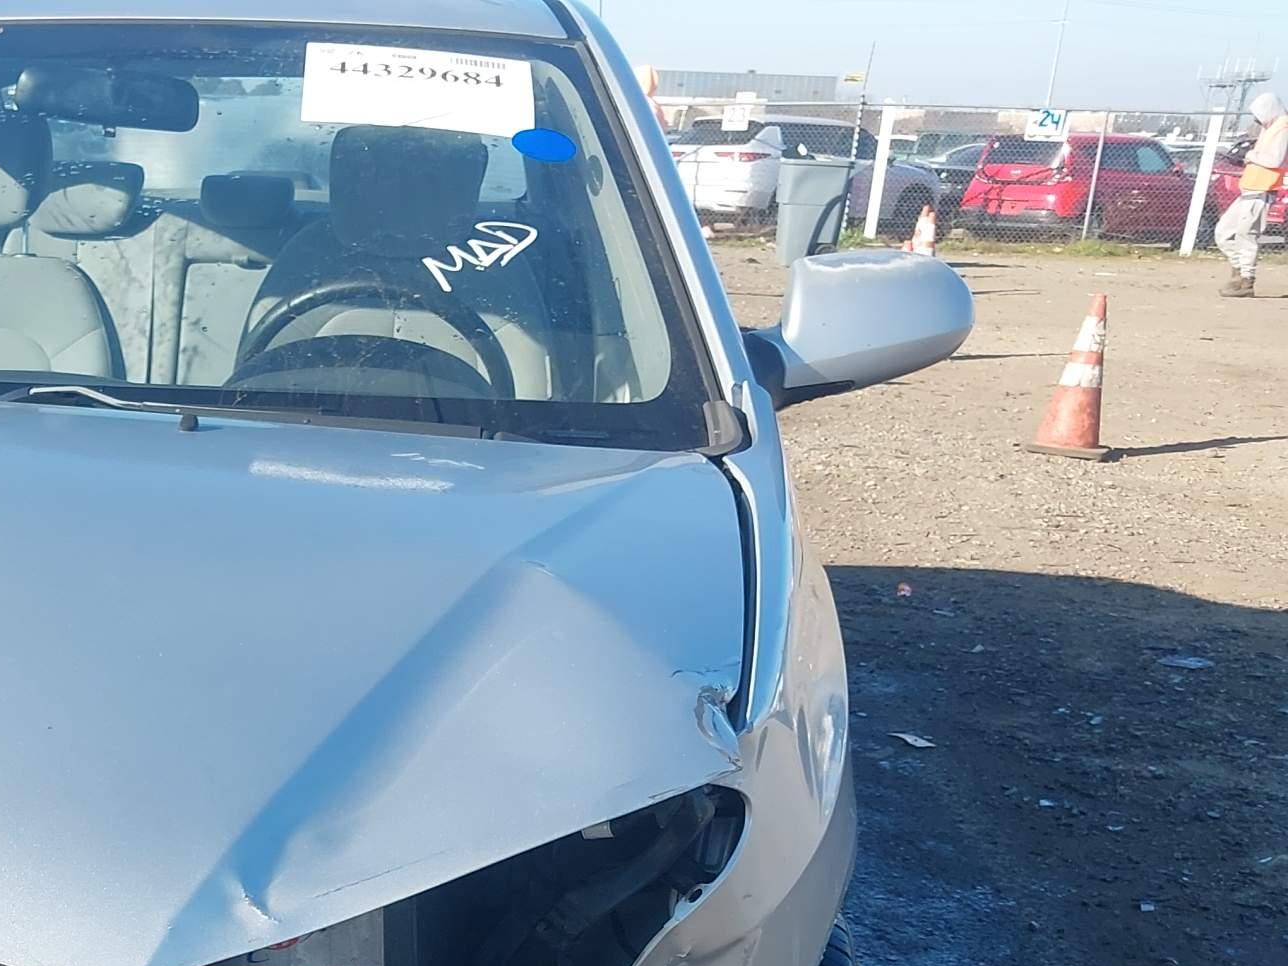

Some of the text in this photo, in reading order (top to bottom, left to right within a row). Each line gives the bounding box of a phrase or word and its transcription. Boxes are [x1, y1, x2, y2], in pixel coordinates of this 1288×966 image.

[329, 61, 503, 88] 44329684
[1039, 110, 1061, 130] 24
[421, 221, 538, 292] MAD
